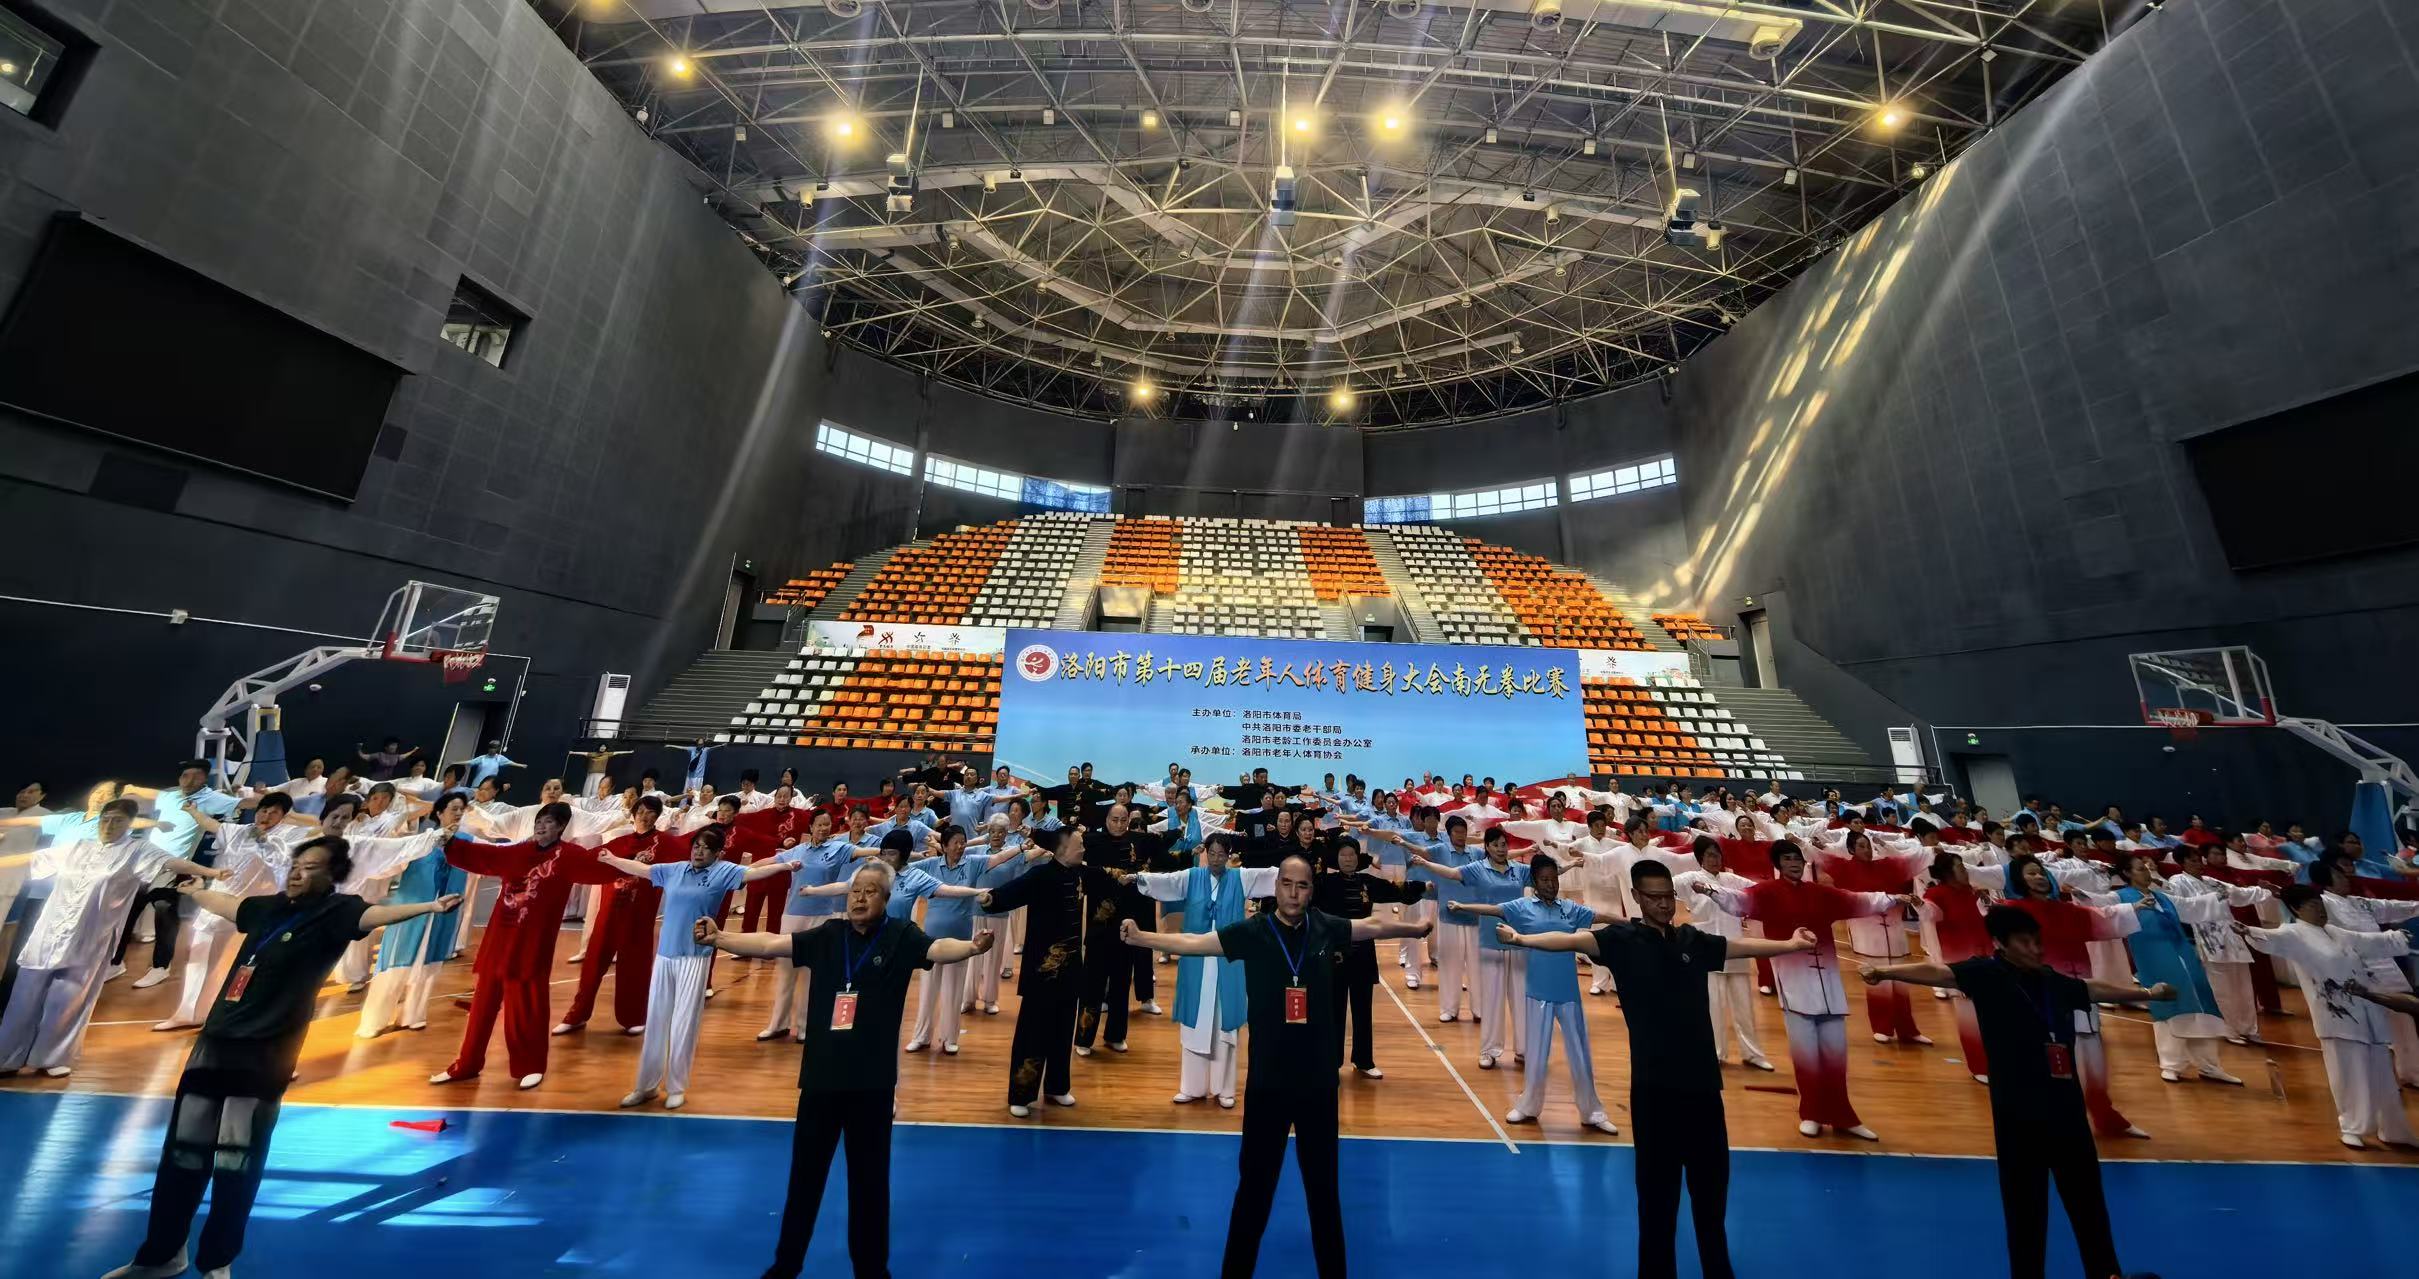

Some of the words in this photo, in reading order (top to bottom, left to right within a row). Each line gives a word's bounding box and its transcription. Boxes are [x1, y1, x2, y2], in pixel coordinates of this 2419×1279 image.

[1060, 650, 1570, 699] 洛阳市第十四届老年人体育健身大会南无拳比赛
[1242, 709, 1302, 721] 洛阳市体育局
[1242, 723, 1342, 735] 中共洛阳市委老干部局
[1242, 735, 1373, 748] 洛阳市老龄工作委员会办公室
[1242, 748, 1343, 760] 洛阳市老年人体育协会
